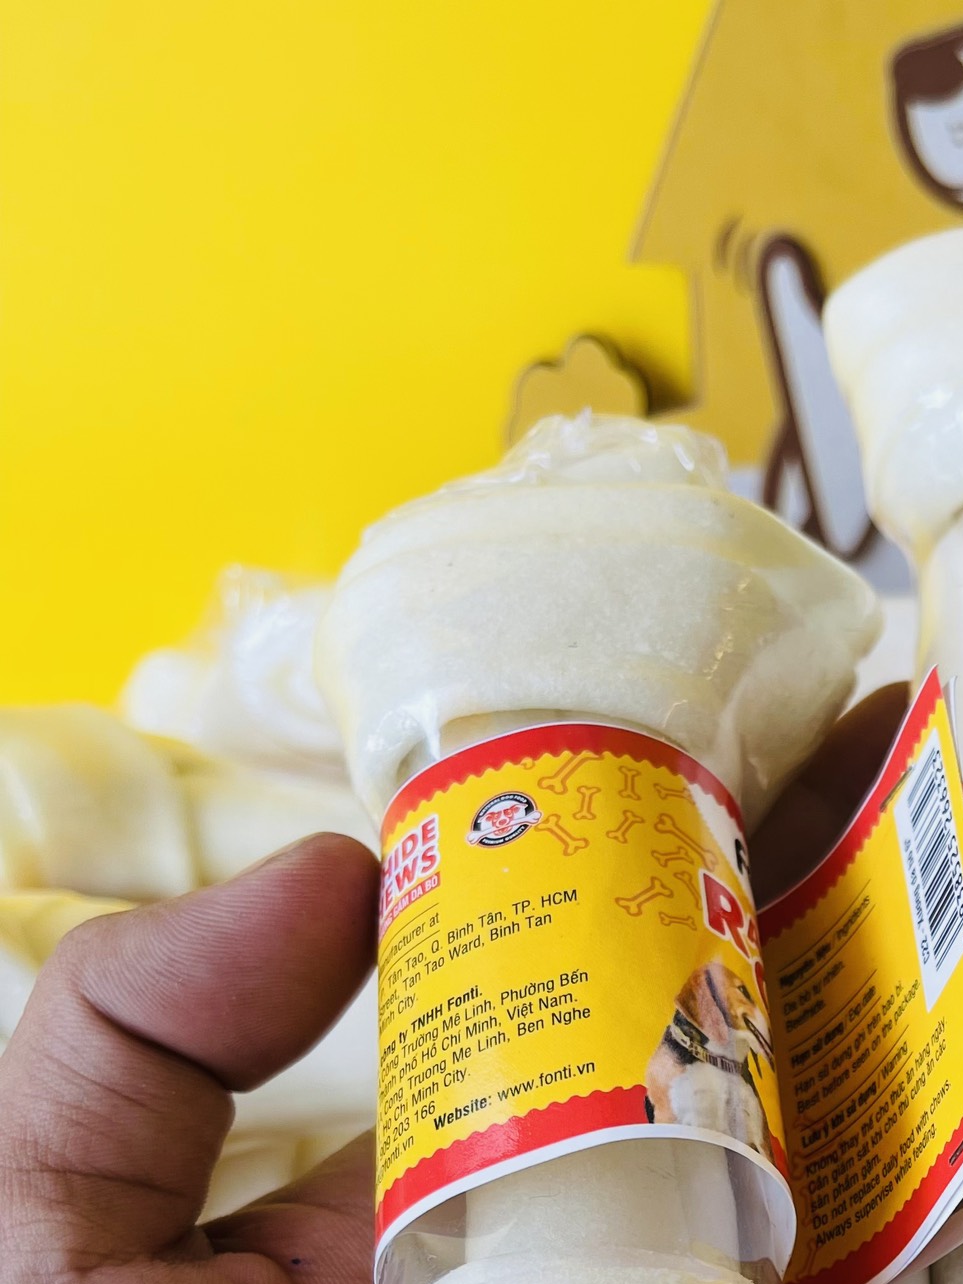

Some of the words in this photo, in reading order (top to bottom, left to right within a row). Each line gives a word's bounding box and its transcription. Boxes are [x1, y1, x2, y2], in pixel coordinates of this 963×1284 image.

[932, 750, 952, 831] 266323
[387, 968, 402, 989] Tân
[405, 952, 427, 972] Tạo,
[431, 940, 443, 954] Q.
[447, 920, 474, 944] Bình
[479, 908, 507, 928] Tân,
[512, 900, 535, 916] TP.
[541, 889, 578, 908] HCM
[403, 971, 421, 992] Tan
[424, 956, 444, 976] Tao
[449, 935, 485, 960] Ward,
[490, 919, 520, 942] Binh
[525, 912, 552, 930] Tan
[429, 912, 440, 926] at
[397, 993, 419, 1015] City.
[399, 1028, 408, 1045] ty
[411, 1006, 443, 1034] TNHH
[447, 986, 483, 1012] Fonti.
[399, 1054, 418, 1080] phố
[421, 1043, 437, 1063] Hồ
[442, 1029, 461, 1051] Chí
[465, 1016, 501, 1040] Minh,
[507, 1001, 534, 1022] Việt
[538, 992, 578, 1011] Nam.
[401, 1026, 438, 1056] Trường
[442, 1013, 461, 1033] Mê
[464, 999, 496, 1024] Linh,
[500, 976, 555, 1006] Phường
[559, 967, 589, 987] Bến
[822, 1071, 850, 1098] before
[852, 1048, 870, 1072] seen
[871, 1037, 882, 1051] on
[882, 1019, 893, 1039] the
[893, 979, 921, 1024] package.
[383, 1085, 404, 1114] Cong
[407, 1058, 447, 1088] Truong
[452, 1047, 472, 1066] Me
[477, 1029, 511, 1052] Linh,
[517, 1018, 545, 1037] Ben
[551, 1006, 591, 1027] Nghe
[393, 1102, 409, 1122] Chi
[411, 1080, 439, 1108] Minh
[443, 1067, 471, 1088] City.
[433, 1094, 493, 1131] Website:
[497, 1062, 596, 1101] www.fonti.vn
[857, 1144, 871, 1164] sát
[871, 1128, 883, 1149] khi
[884, 1113, 898, 1135] cho
[926, 1058, 935, 1077] ăn
[935, 1039, 947, 1062] các
[881, 1040, 909, 1081] Warning
[392, 1120, 410, 1143] 203
[414, 1101, 436, 1123] 166
[806, 1150, 839, 1178] Không
[840, 1133, 859, 1157] thay
[875, 1098, 889, 1120] cho
[915, 1046, 931, 1073] hàng
[812, 1212, 829, 1230] Do
[831, 1200, 848, 1219] not
[849, 1171, 881, 1212] replace
[881, 1151, 899, 1178] daily
[899, 1130, 916, 1156] food
[915, 1109, 931, 1136] with
[930, 1079, 952, 1115] chews.
[815, 1216, 853, 1248] Always
[854, 1180, 894, 1223] supervise
[894, 1159, 913, 1186] while
[912, 1120, 938, 1164] feeding.
